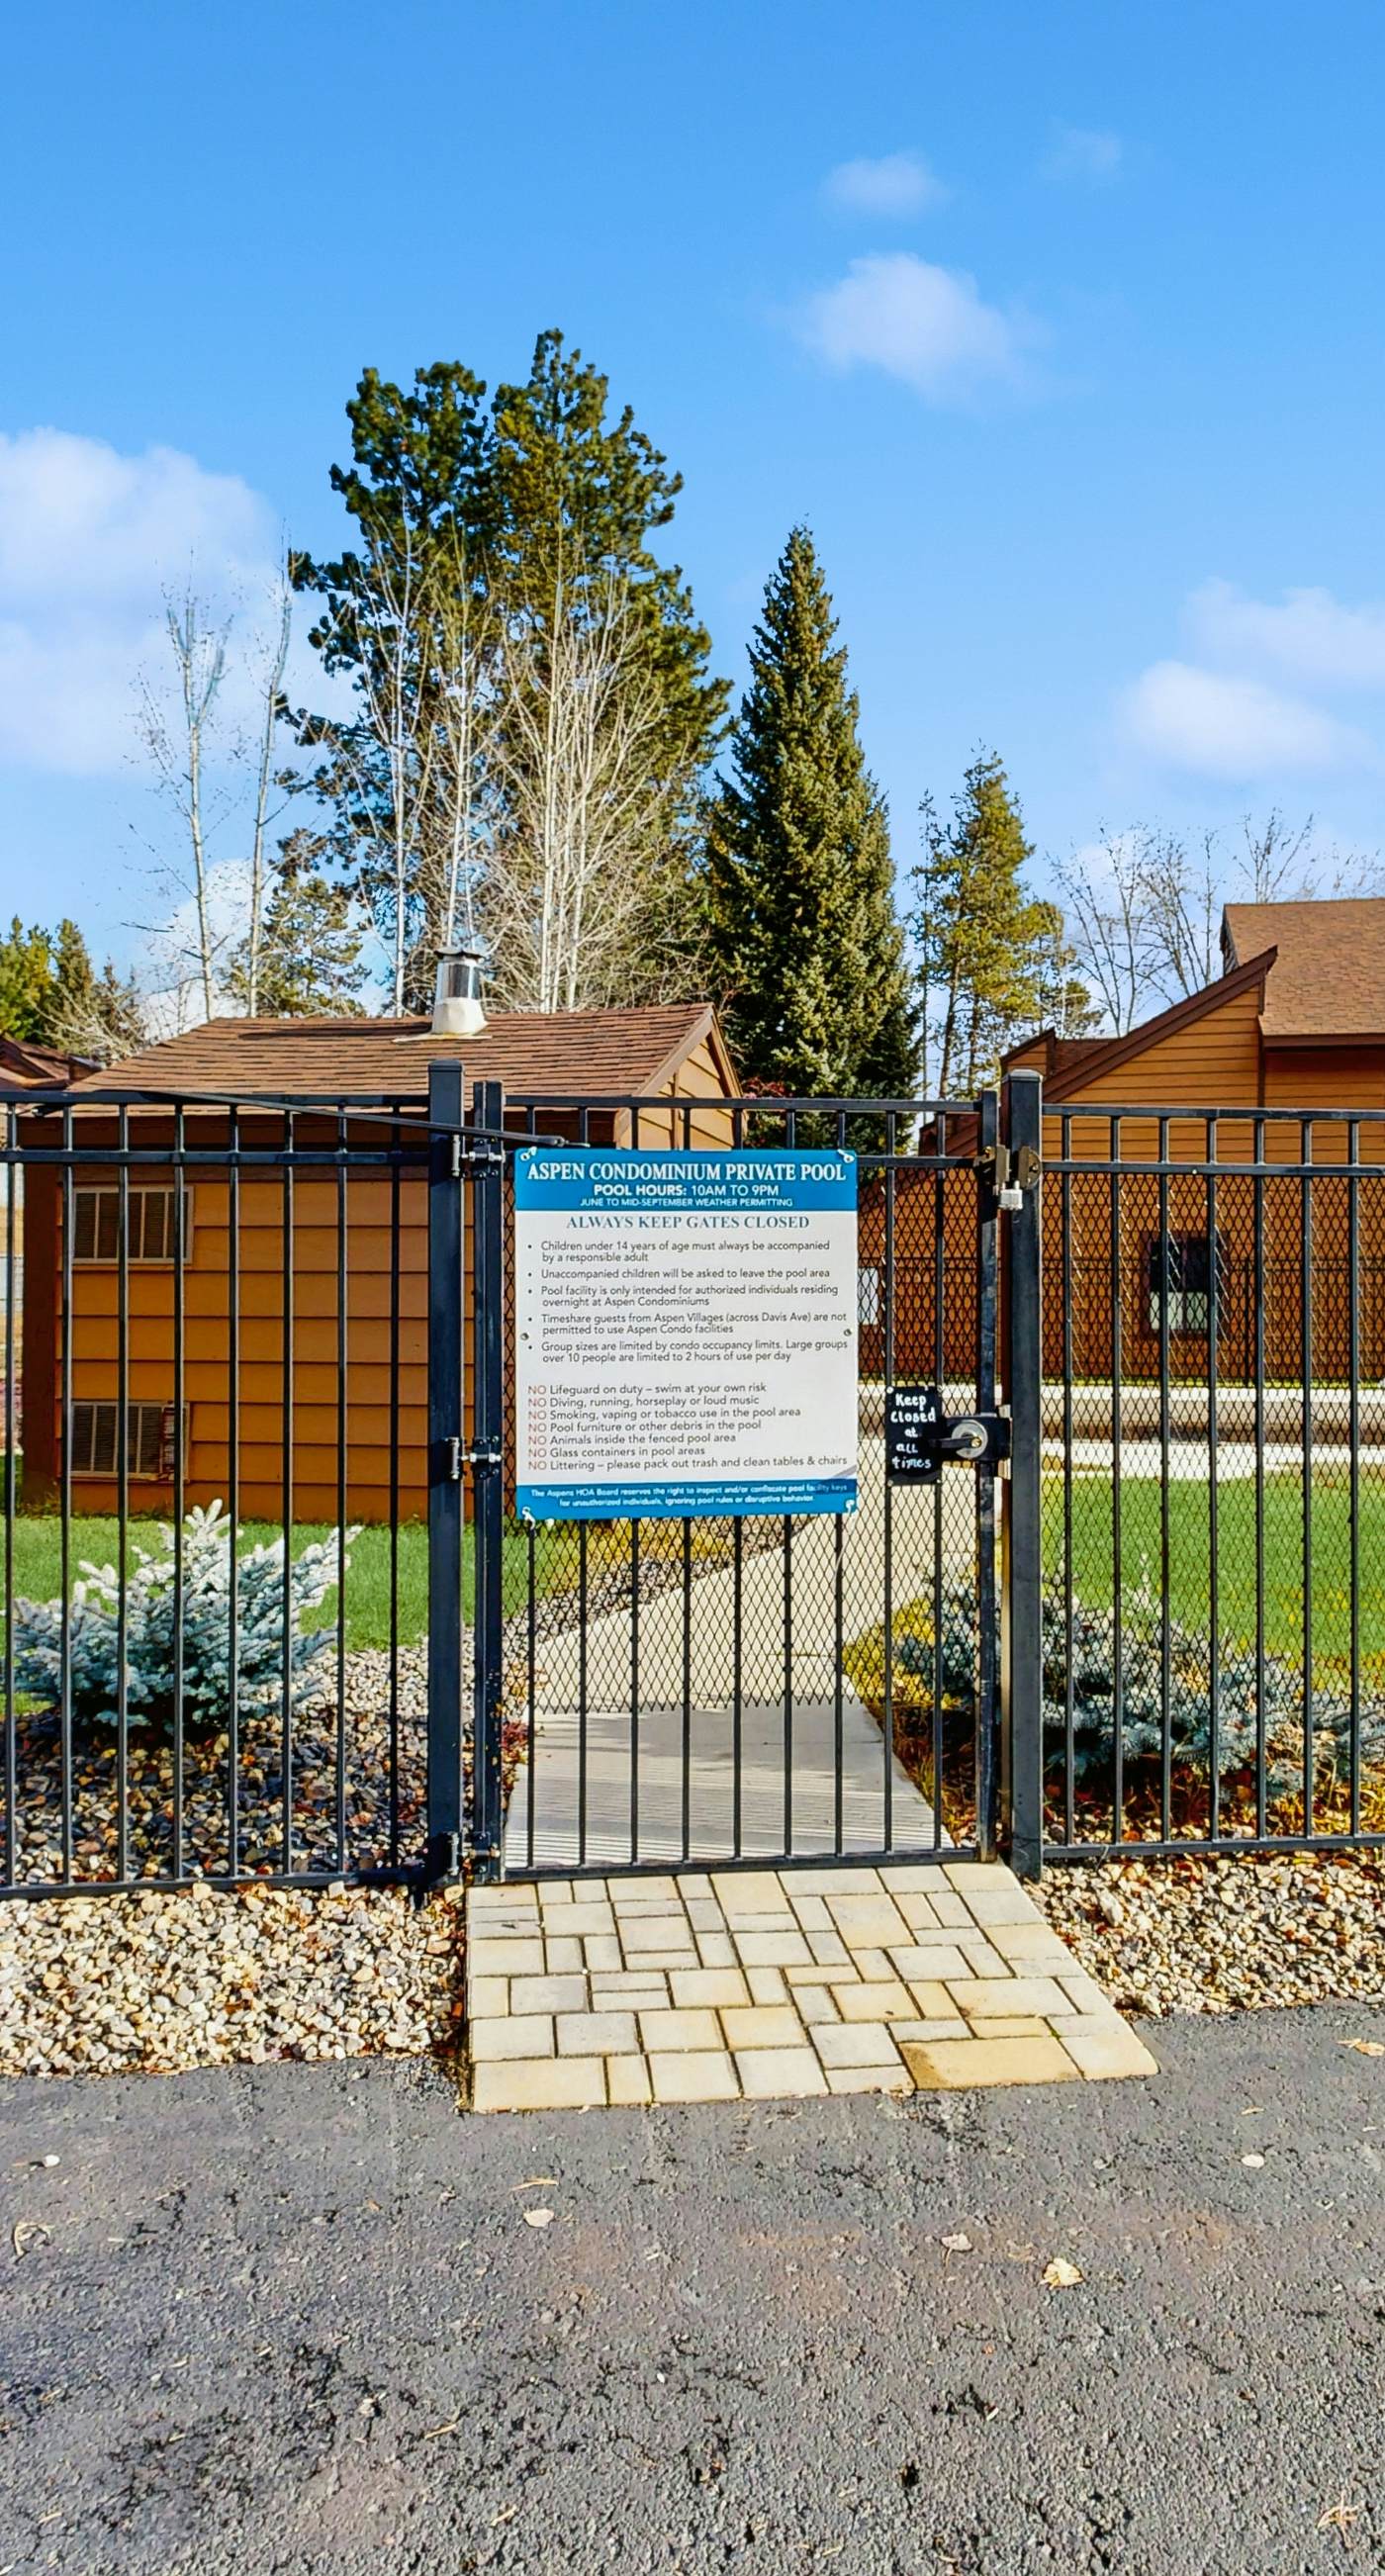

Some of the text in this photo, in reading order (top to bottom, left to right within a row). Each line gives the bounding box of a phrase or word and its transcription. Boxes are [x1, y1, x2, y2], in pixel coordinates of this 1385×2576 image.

[527, 1163, 846, 1180] ASPEN CONDOMINIUM PRIVATE POOL
[594, 1184, 779, 1196] POOL HOURS: 10AM TO 9PM
[580, 1198, 792, 1207] JUNE TO MID-SEPTEMBER WEATHER PERMITTING
[567, 1216, 809, 1229] ALWAYS KEEP GATES CLOSED
[541, 1241, 830, 1253] Children under 14 years of age must always be accompanied
[542, 1251, 649, 1264] by responsible adult
[541, 1268, 618, 1281] Unaccompanied
[622, 1268, 660, 1278] children
[663, 1268, 679, 1278] will
[682, 1268, 693, 1278] be
[696, 1268, 724, 1278] asked
[727, 1268, 737, 1278] to
[740, 1268, 765, 1278] leave
[768, 1268, 783, 1277] the
[785, 1268, 806, 1280] pool
[541, 1284, 838, 1298] Pool facility only intended for authorized individuals residing
[543, 1296, 709, 1309] overnight at Aspen Condominiums
[541, 1313, 591, 1323] Timeshare
[595, 1313, 625, 1326] guests
[629, 1313, 651, 1323] from
[654, 1313, 684, 1325] Aspen
[688, 1312, 723, 1325] Villages
[726, 1312, 759, 1325] (across
[762, 1312, 786, 1322] Davis
[790, 1312, 810, 1325] Ave)
[831, 1312, 847, 1321] not
[543, 1325, 592, 1337] permitted
[595, 1325, 604, 1334] to
[627, 1324, 657, 1336] Aspen
[660, 1324, 692, 1334] Condo
[695, 1324, 733, 1334] facilities
[541, 1341, 572, 1354] Group
[576, 1340, 599, 1350] sizes
[619, 1340, 652, 1350] limited
[670, 1340, 699, 1349] condo
[703, 1341, 752, 1352] occupancy
[756, 1339, 783, 1349] limits.
[785, 1339, 812, 1351] Large
[815, 1341, 848, 1351] groups
[568, 1352, 580, 1362] 10
[583, 1352, 616, 1365] people
[637, 1351, 670, 1361] limited
[673, 1351, 683, 1361] to
[694, 1351, 720, 1361] hours
[756, 1353, 771, 1363] per
[774, 1350, 790, 1363] day
[528, 1384, 546, 1394] NO
[550, 1384, 600, 1397] Lifeguard
[619, 1383, 643, 1396] duty
[655, 1383, 681, 1393] swim
[685, 1383, 694, 1392] at
[697, 1385, 720, 1395] your
[749, 1382, 767, 1392] risk
[528, 1397, 546, 1407] NO
[550, 1397, 587, 1410] Diving,
[591, 1396, 633, 1410] running,
[636, 1396, 687, 1409] horseplay
[703, 1395, 726, 1405] loud
[730, 1395, 759, 1405] music
[895, 1393, 926, 1411] Keep
[528, 1410, 546, 1420] NO
[550, 1409, 599, 1423] Smoking,
[602, 1409, 637, 1422] vaping
[655, 1408, 696, 1418] tobacco
[733, 1407, 750, 1417] the
[753, 1407, 776, 1420] pool
[528, 1423, 546, 1432] NO
[550, 1423, 574, 1431] Pool
[577, 1422, 621, 1431] furniture
[639, 1421, 667, 1430] other
[670, 1421, 702, 1430] debris
[705, 1420, 714, 1429] in
[718, 1420, 735, 1429] the
[738, 1420, 761, 1432] pool
[904, 1426, 918, 1437] at
[528, 1435, 546, 1444] NO
[550, 1434, 591, 1444] Animals
[595, 1433, 625, 1443] inside
[629, 1433, 646, 1443] the
[649, 1433, 684, 1443] fenced
[688, 1432, 710, 1445] pool
[528, 1447, 546, 1457] NO
[550, 1447, 578, 1457] Glass
[582, 1446, 635, 1456] containers
[639, 1446, 648, 1455] in
[651, 1445, 675, 1458] pool
[528, 1455, 847, 1473] NO Littering please pack out trash and clean tables chairs
[892, 1456, 931, 1468] times
